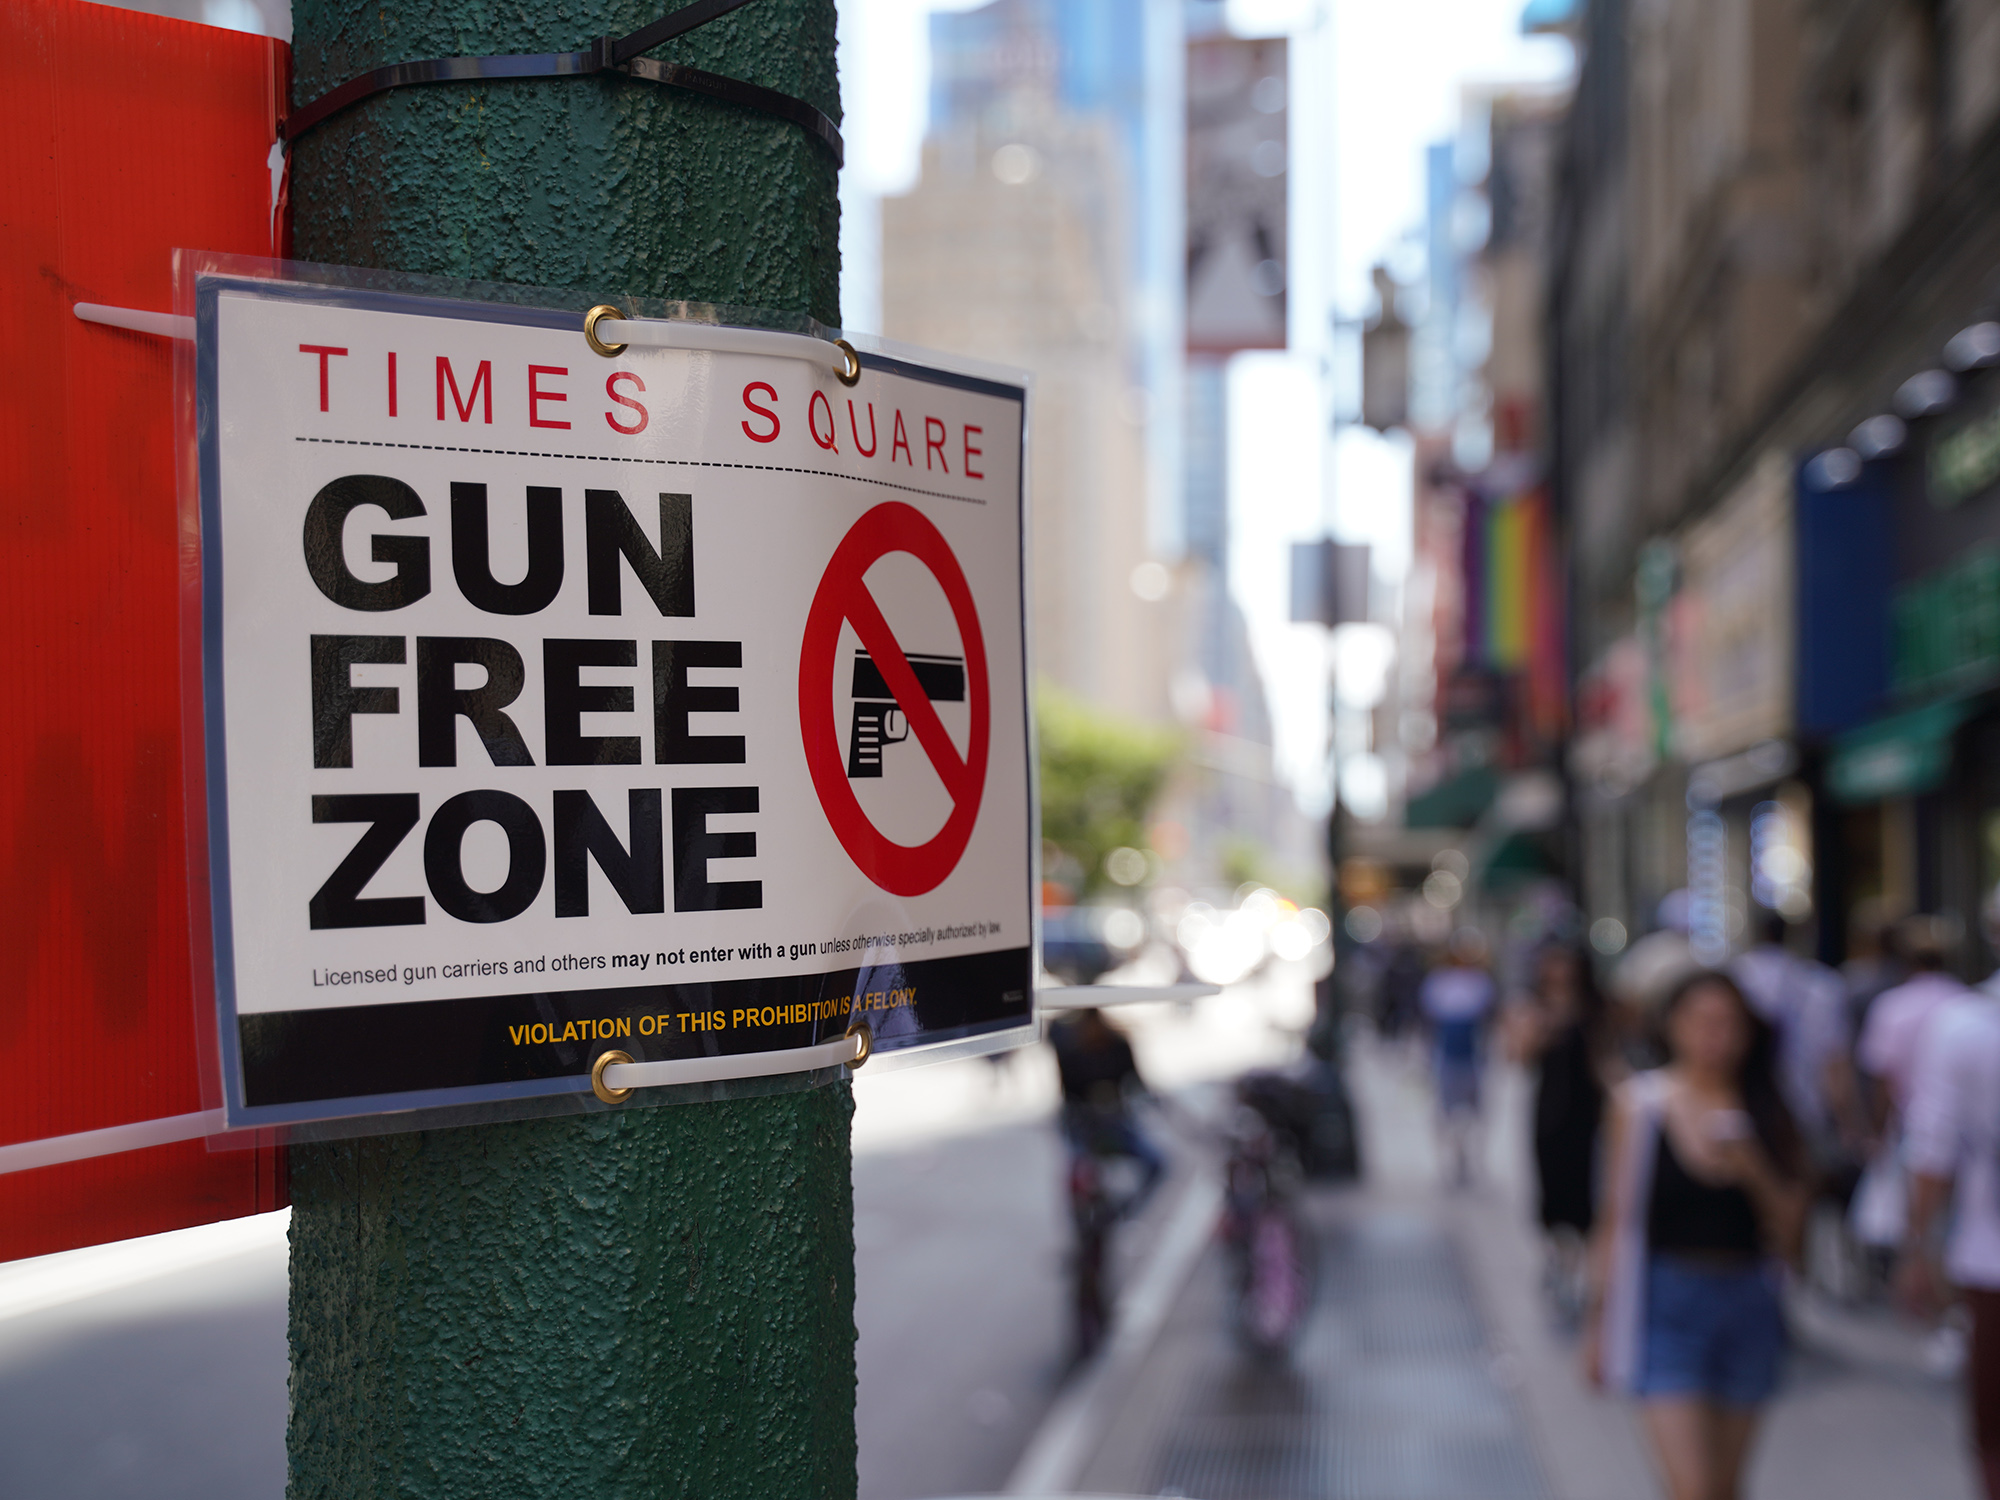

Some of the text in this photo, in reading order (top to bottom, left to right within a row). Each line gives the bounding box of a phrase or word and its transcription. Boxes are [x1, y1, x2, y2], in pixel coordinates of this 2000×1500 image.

[300, 344, 986, 480] TIMES SQUARE
[303, 474, 696, 618] GUN
[310, 634, 746, 769] FREE
[309, 786, 763, 930] ZONE
[313, 964, 397, 987] Licensed
[403, 965, 436, 985] gun
[442, 959, 508, 978] carriers
[513, 955, 546, 973] and
[551, 953, 606, 971] others
[612, 953, 650, 970] may
[656, 948, 685, 965] not
[690, 946, 734, 963] enter
[738, 943, 772, 960] with
[776, 945, 785, 957] a
[789, 942, 816, 960] gun
[820, 937, 850, 954] unless
[852, 932, 896, 950] otherwise
[898, 927, 935, 948] specially
[937, 922, 977, 941] authorized
[978, 921, 987, 938] by
[509, 987, 917, 1046] VIOLATION OF THIS PROHIBITION IS A FELONY.
